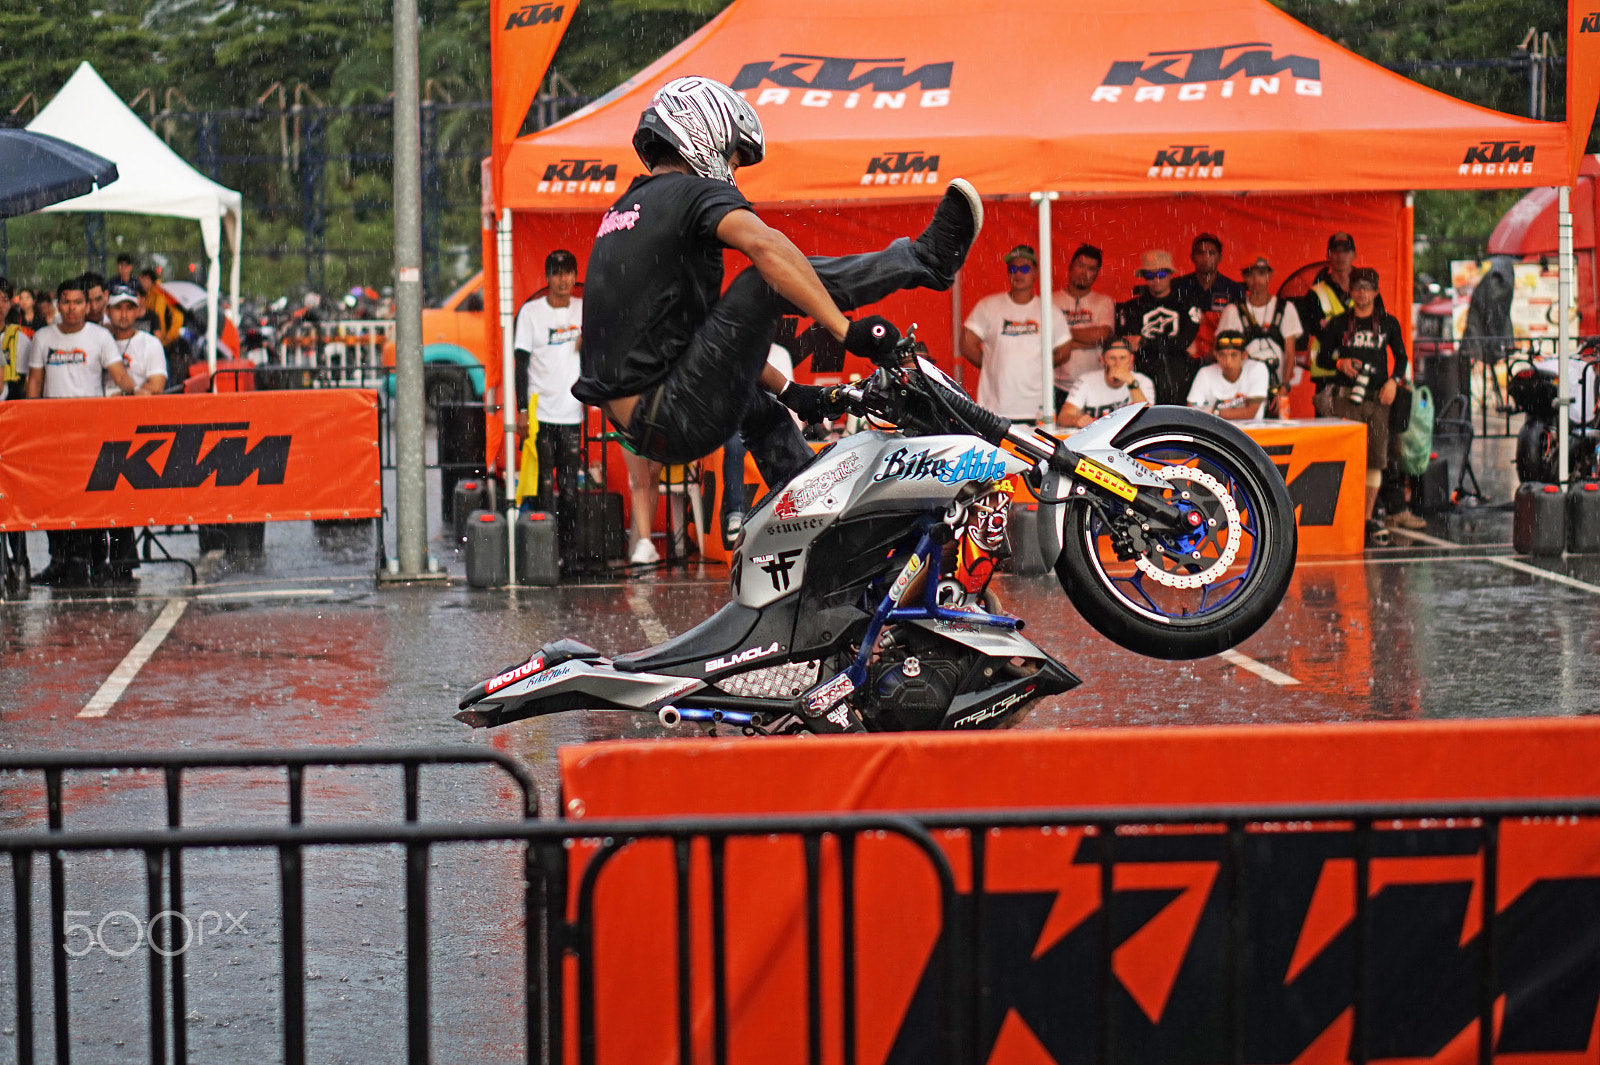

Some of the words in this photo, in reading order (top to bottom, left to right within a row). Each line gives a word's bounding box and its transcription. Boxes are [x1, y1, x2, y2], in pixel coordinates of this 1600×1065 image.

[504, 3, 564, 31] KTM
[730, 53, 954, 92] KTM
[1101, 42, 1321, 86] KTM
[740, 88, 951, 109] ACING
[1090, 77, 1323, 103] RACING
[866, 151, 940, 174] KTM
[1152, 145, 1225, 166] KTM
[1463, 141, 1536, 163] KTM
[542, 159, 618, 181] KTM
[860, 171, 938, 185] RACING
[1147, 166, 1223, 178] RACING
[1458, 163, 1534, 175] RACING
[537, 181, 616, 193] RACING
[85, 421, 292, 491] KTM
[1079, 462, 1133, 494] PIRELLI
[705, 641, 779, 673] BILMOLA
[488, 659, 541, 691] MOTUL
